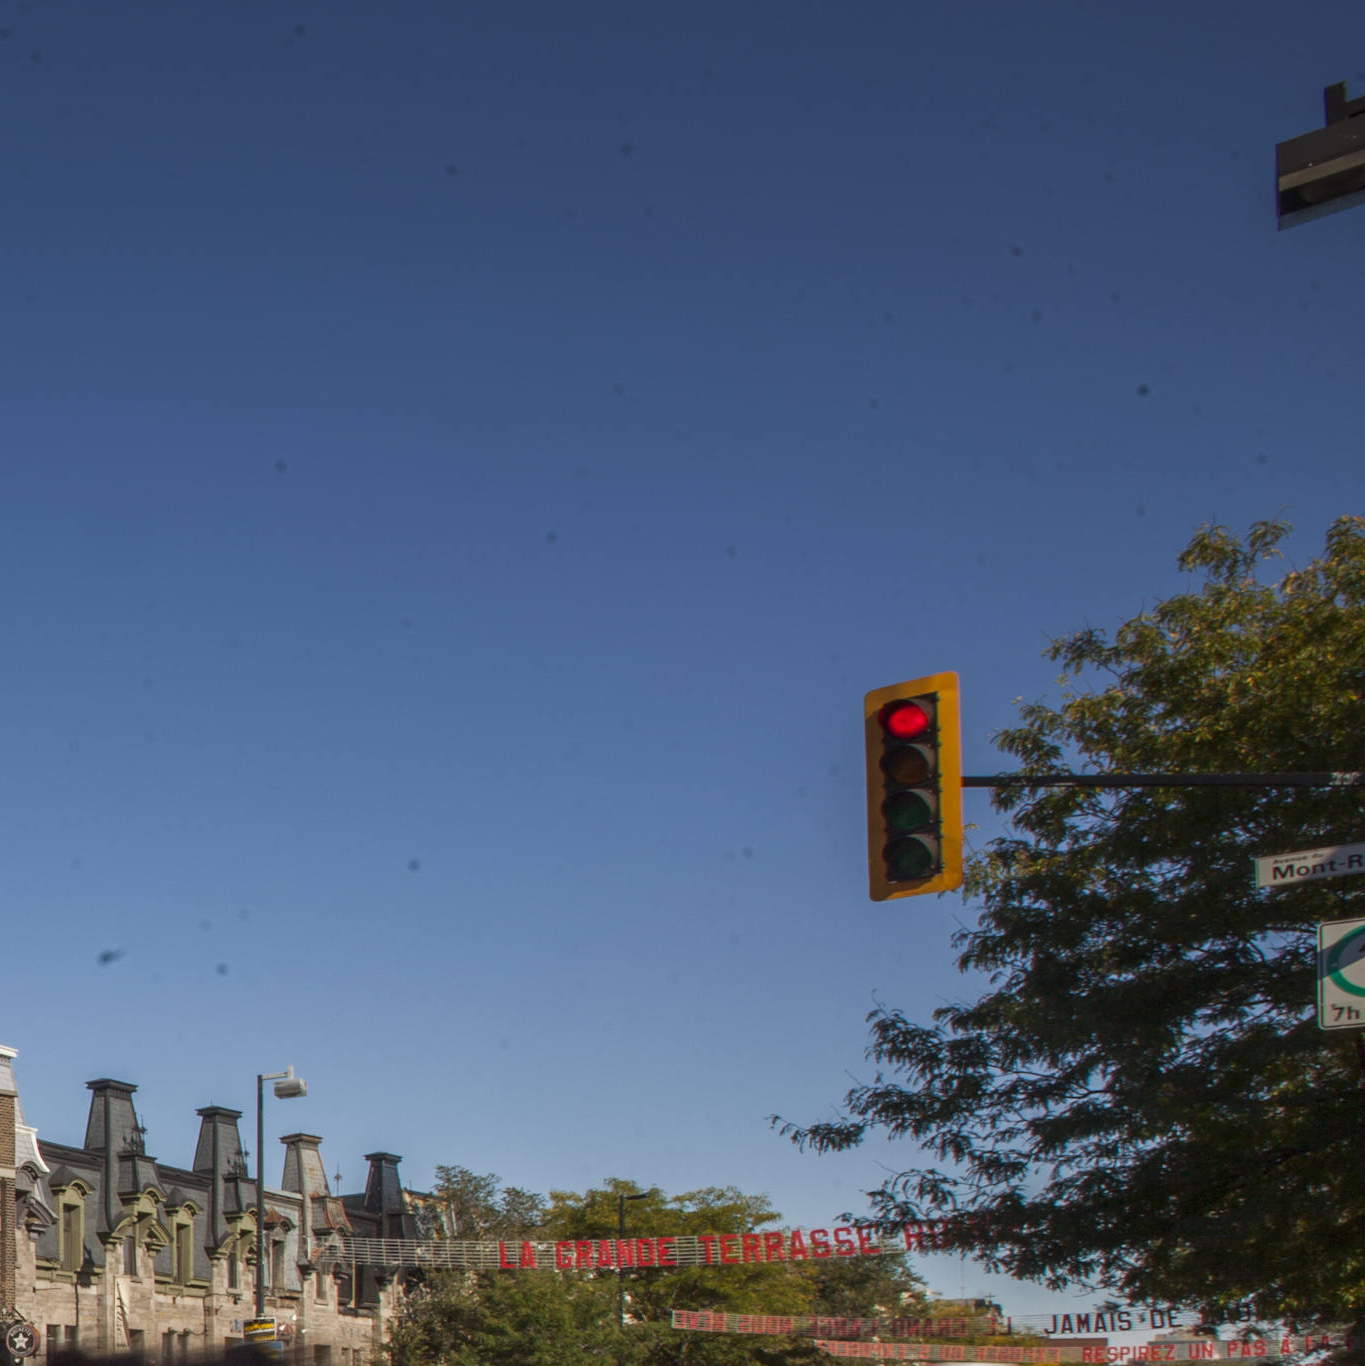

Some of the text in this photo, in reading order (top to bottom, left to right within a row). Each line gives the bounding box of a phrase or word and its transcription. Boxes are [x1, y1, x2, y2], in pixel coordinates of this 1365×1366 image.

[1272, 854, 1308, 865] Avenue
[1332, 1005, 1361, 1022] 7h
[500, 1241, 537, 1269] LA
[555, 1237, 677, 1268] GRANDE
[698, 1224, 882, 1265] TERRASSE
[1044, 1311, 1132, 1334] JAMAIS
[1150, 1309, 1183, 1330] DE
[1082, 1343, 1176, 1363] RESPIREZ
[1189, 1342, 1214, 1359] UN
[1227, 1340, 1268, 1358] PAS
